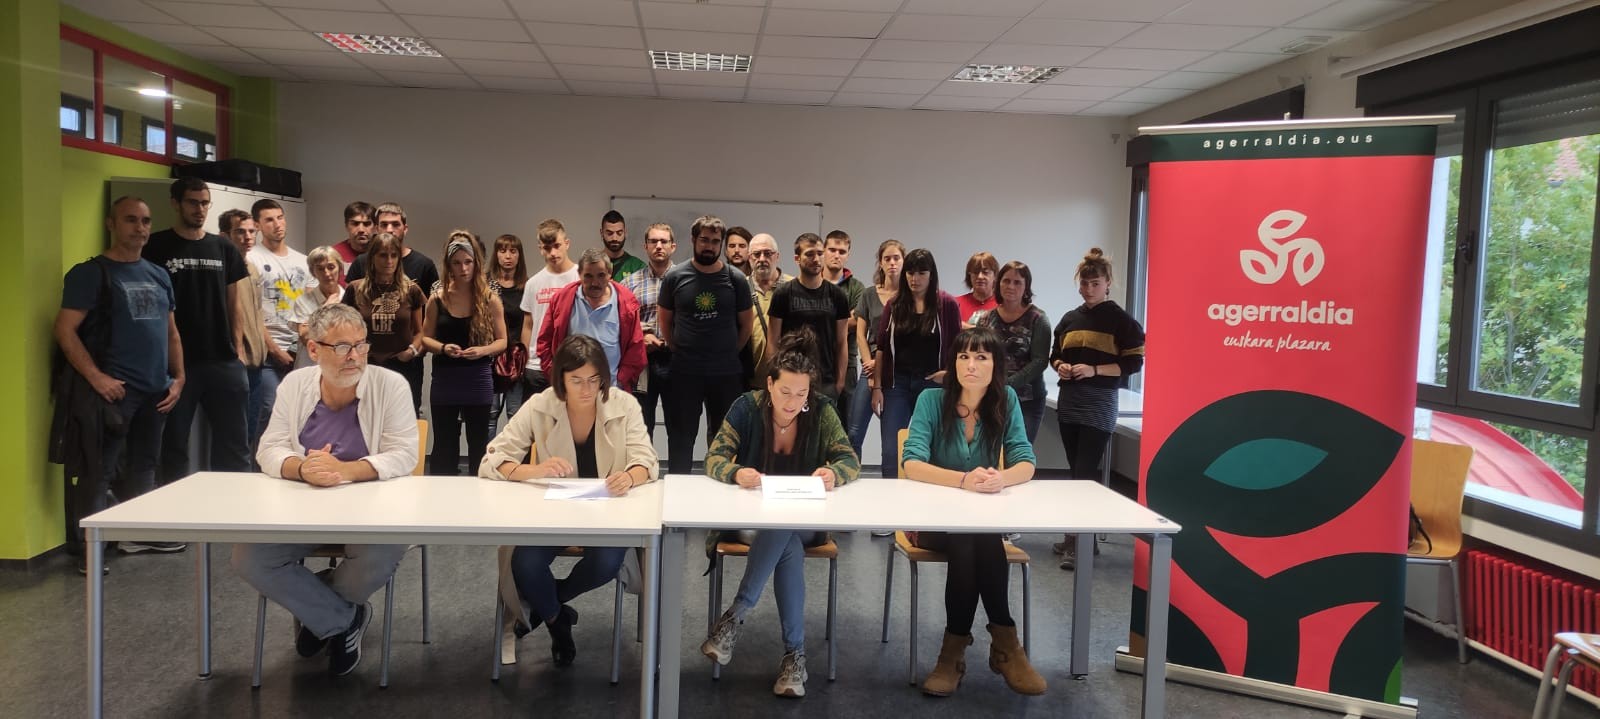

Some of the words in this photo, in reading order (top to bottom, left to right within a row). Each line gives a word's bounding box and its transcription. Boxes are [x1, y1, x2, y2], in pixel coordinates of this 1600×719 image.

[1203, 134, 1373, 150] agerraldia.eus
[1207, 300, 1354, 326] agerraldia
[1223, 330, 1275, 349] euskara
[1275, 333, 1332, 353] plazara
